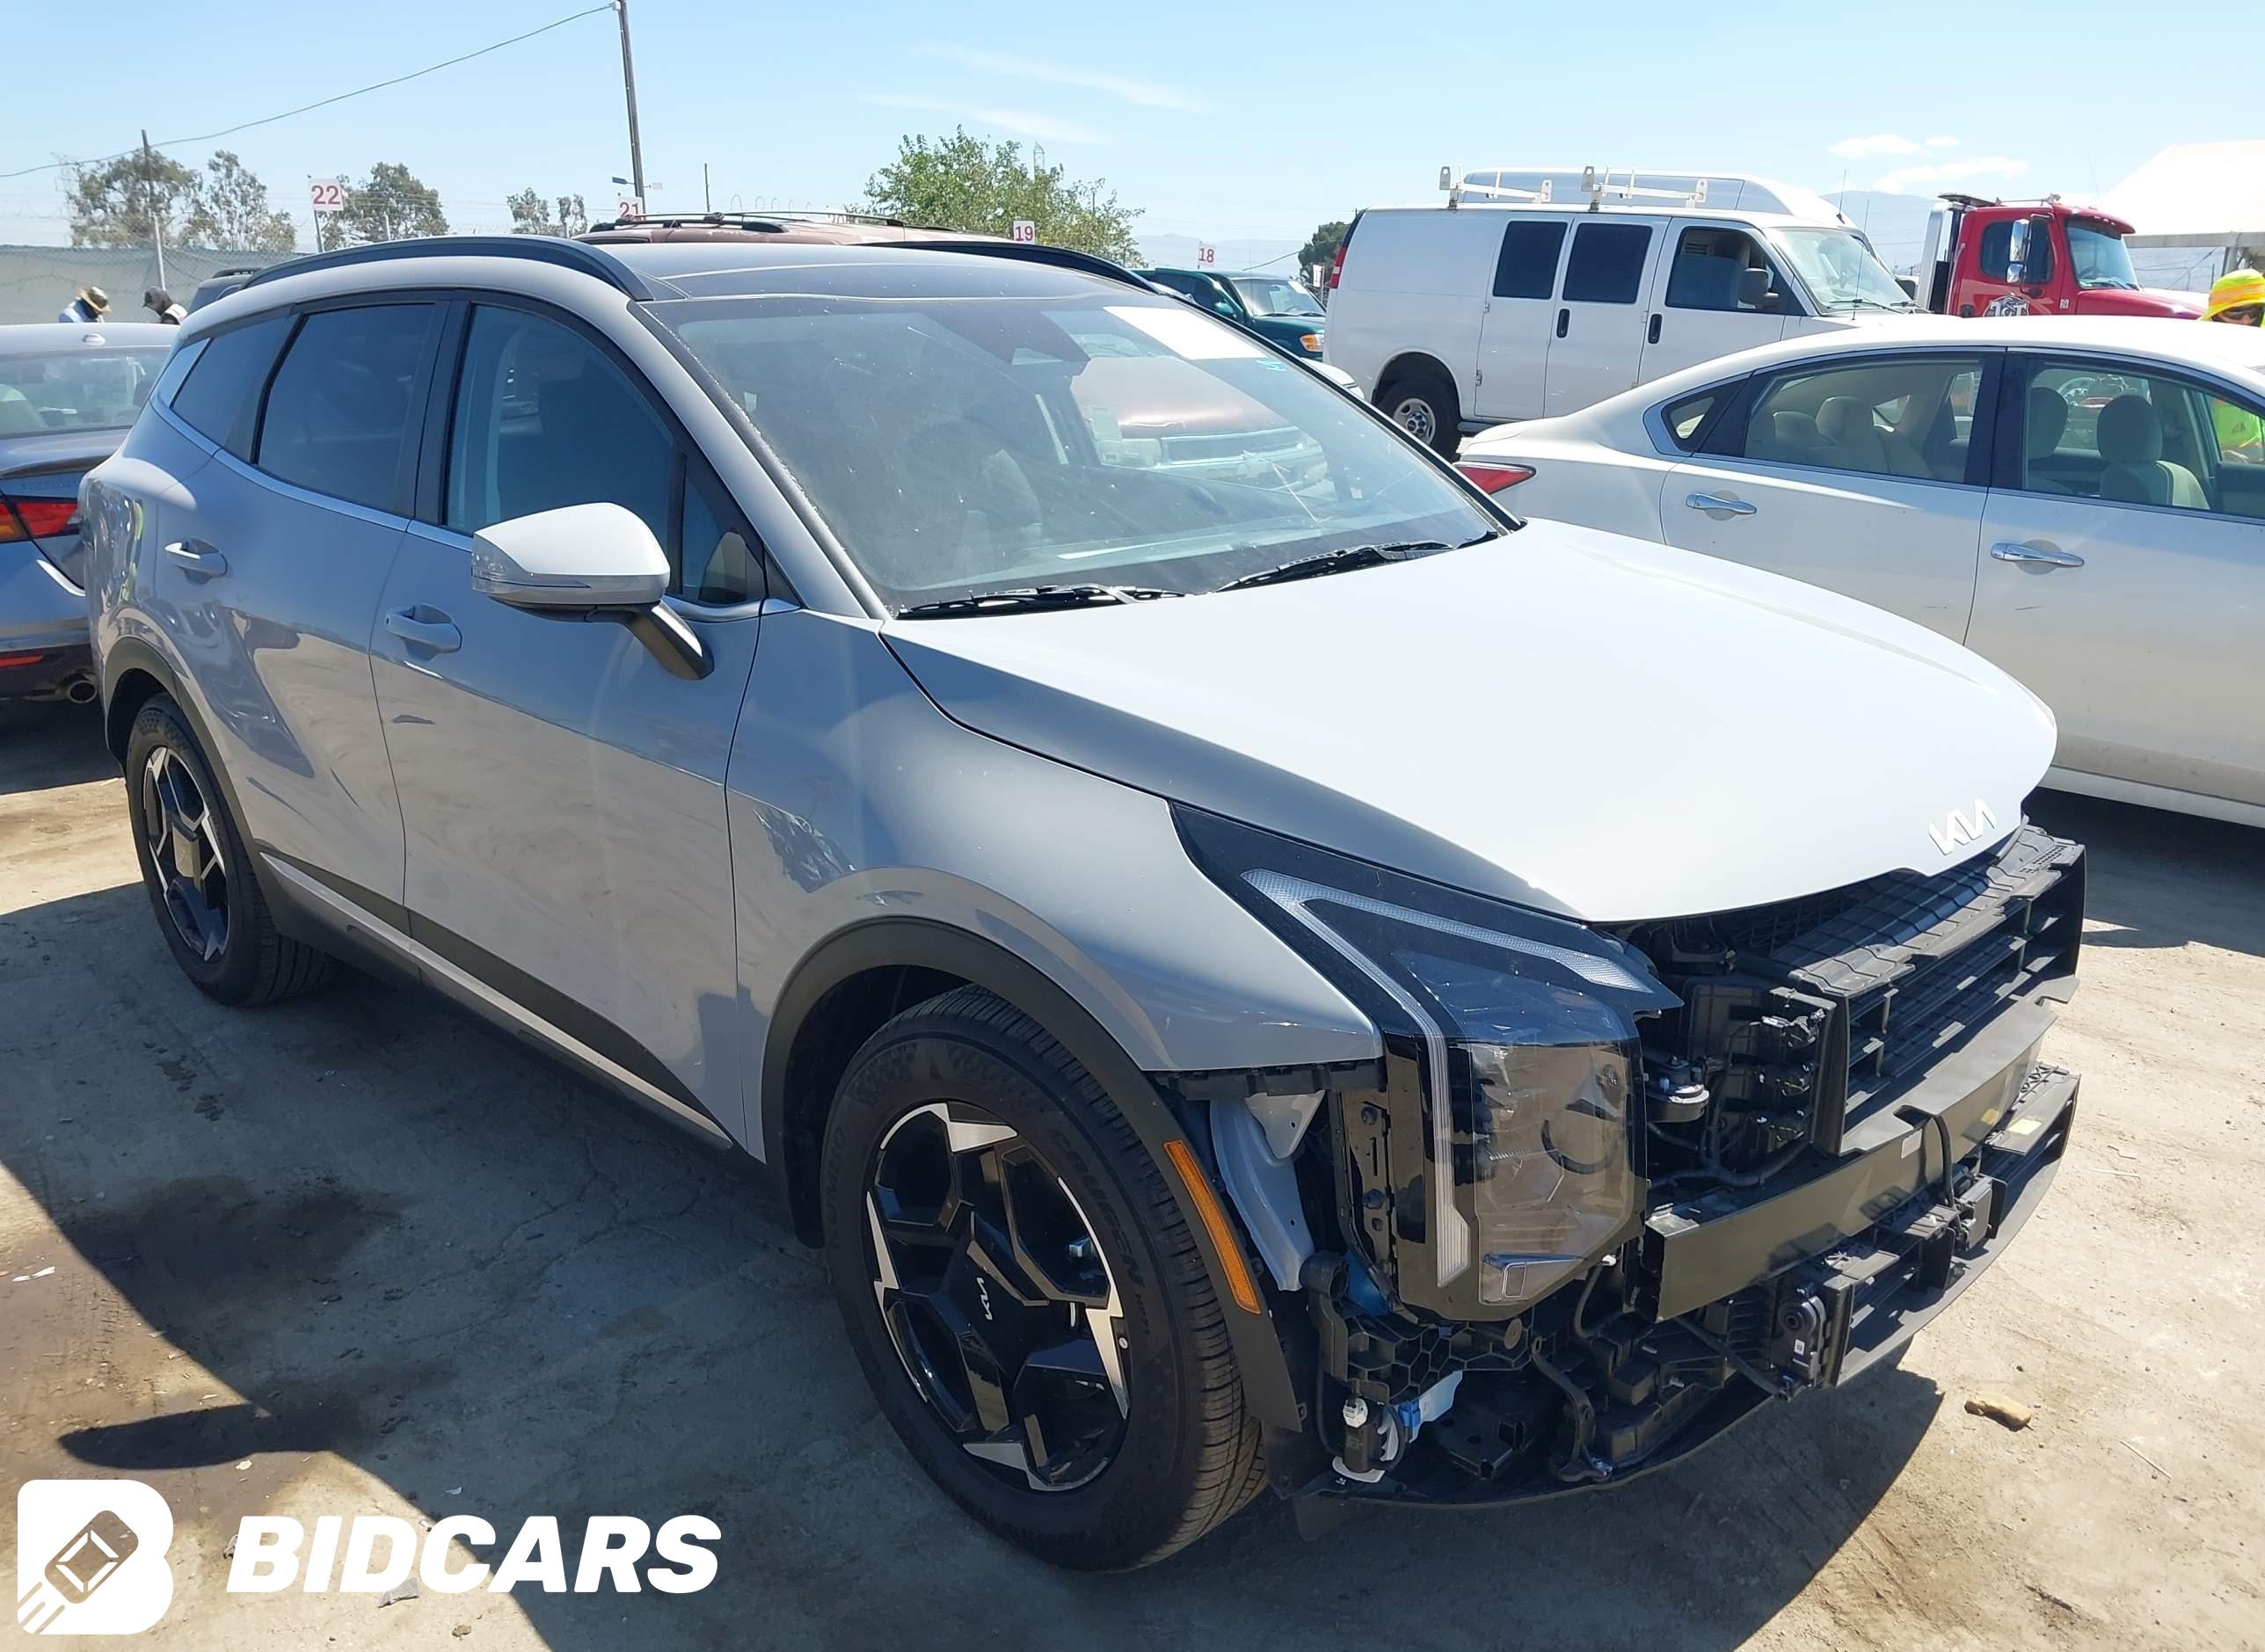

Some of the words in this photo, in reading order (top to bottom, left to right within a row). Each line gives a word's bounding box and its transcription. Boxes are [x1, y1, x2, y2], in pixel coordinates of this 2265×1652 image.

[311, 186, 340, 205] 22
[619, 201, 638, 218] 21
[1015, 225, 1033, 241] 19
[1198, 247, 1214, 263] 18
[1928, 798, 1997, 855] KIA
[977, 1277, 993, 1321] KIA
